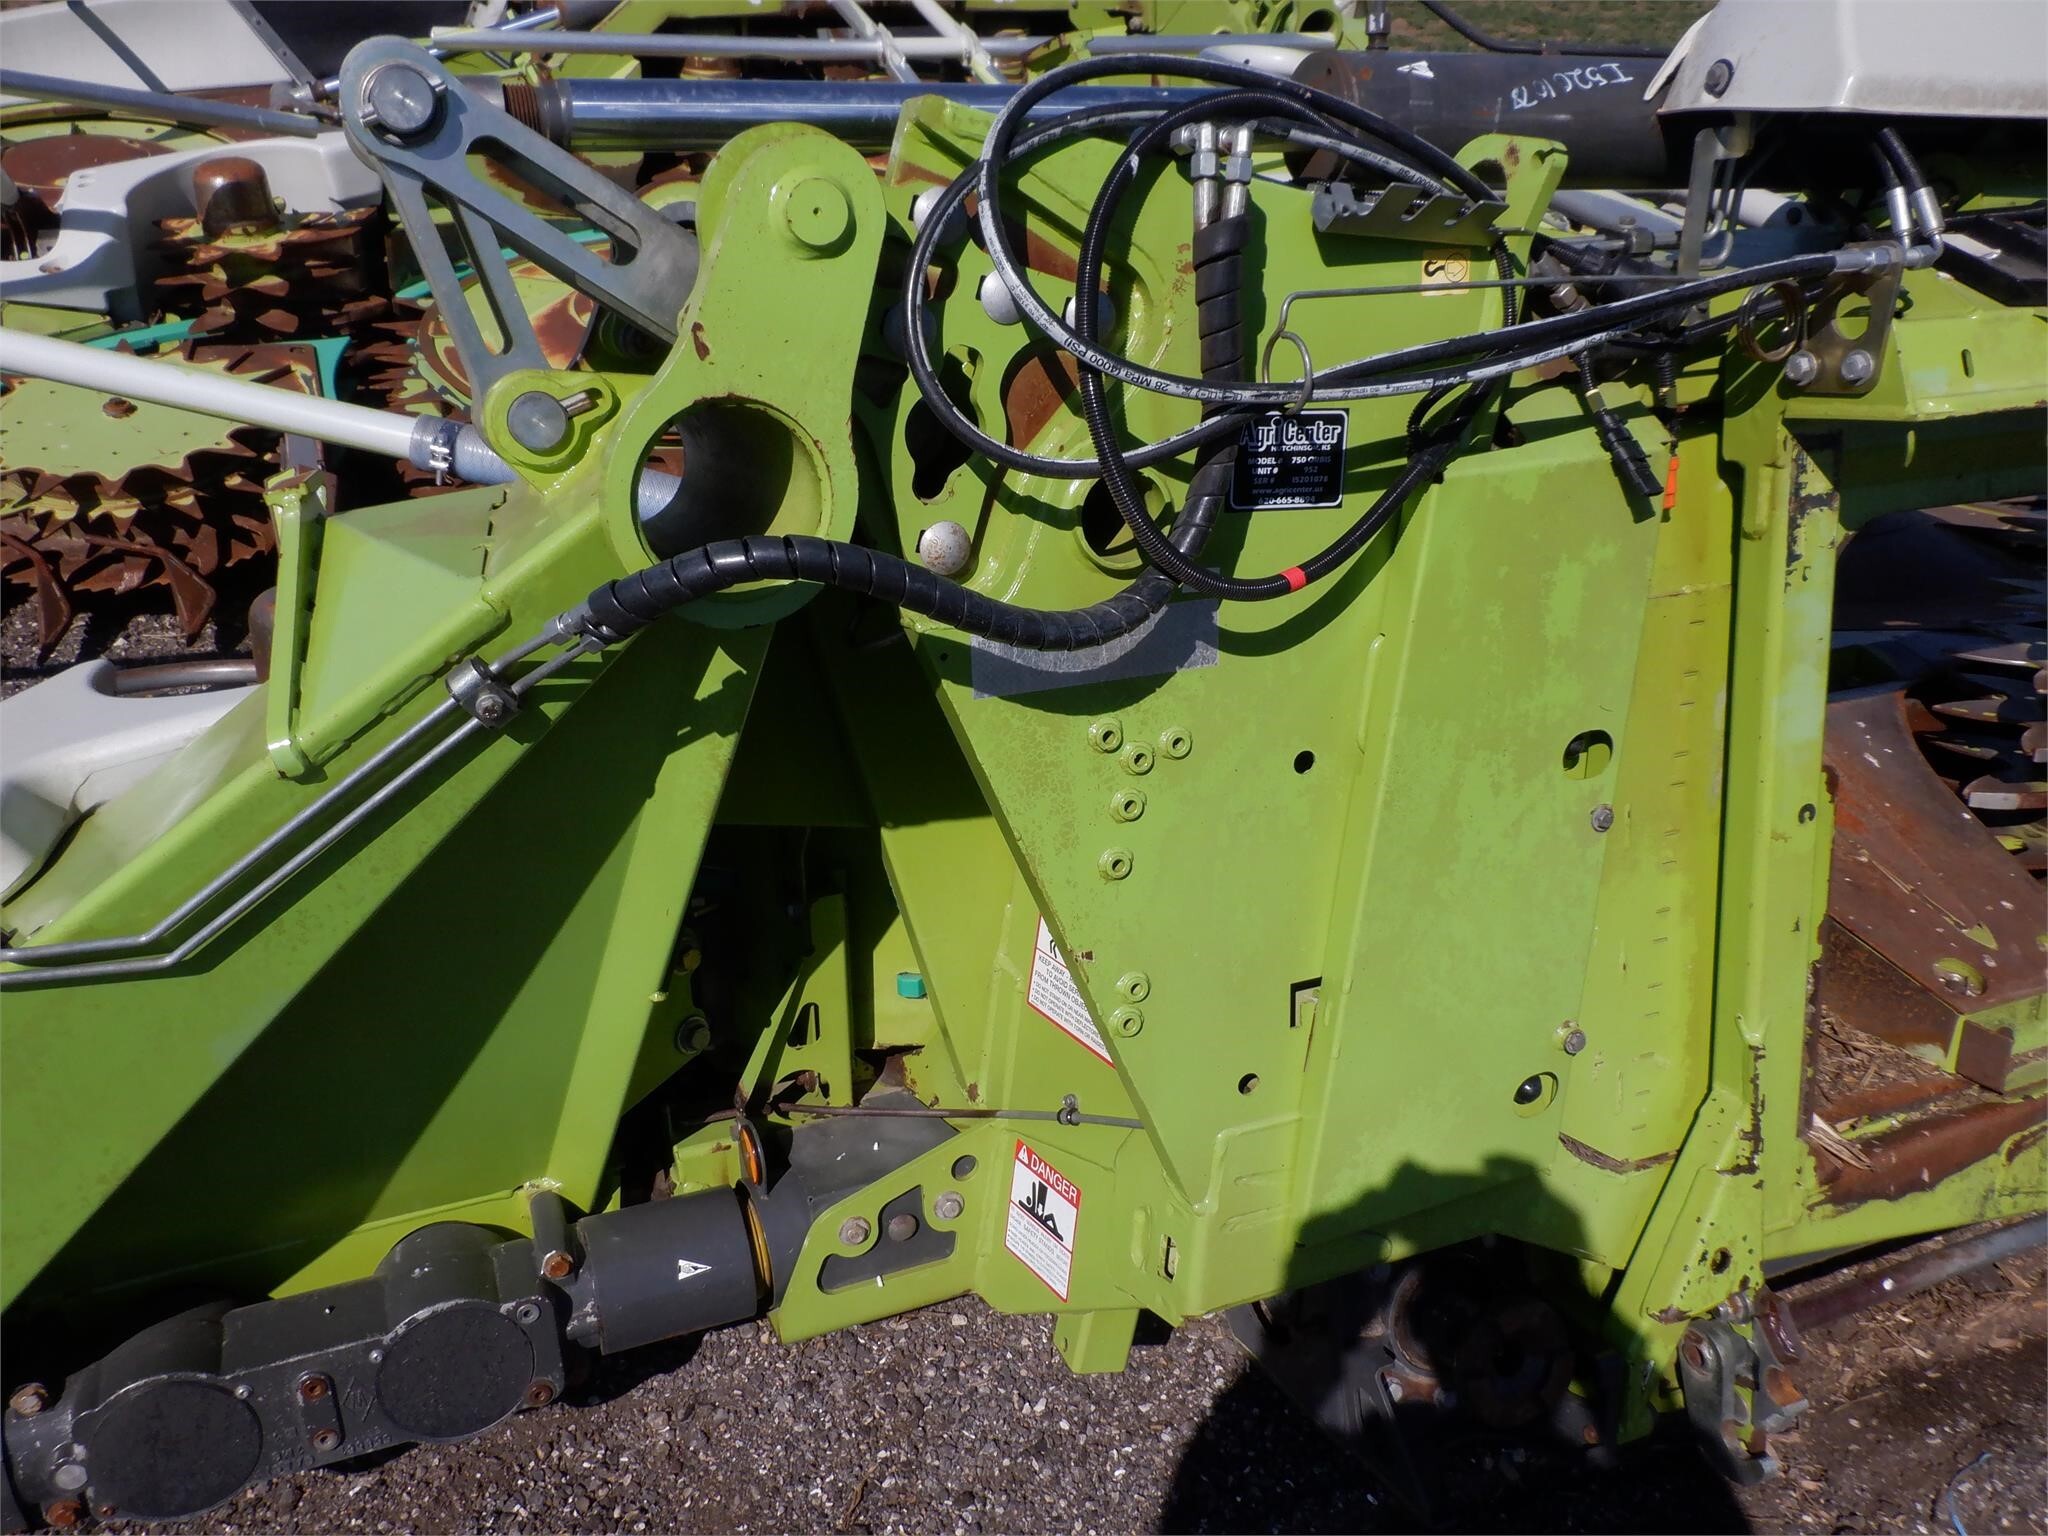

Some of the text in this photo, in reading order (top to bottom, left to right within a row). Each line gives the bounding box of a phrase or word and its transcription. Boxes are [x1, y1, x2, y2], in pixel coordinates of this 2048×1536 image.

[1063, 337, 1088, 358] PSI)
[1089, 353, 1122, 377] (4000
[1155, 380, 1170, 392] 28
[1247, 456, 1277, 465] MODEL
[1291, 455, 1306, 465] 750
[1251, 466, 1272, 475] UNIT
[1038, 955, 1066, 977] KEEP AWAY
[1034, 969, 1049, 985] FROM
[1049, 980, 1071, 1000] THROWN
[1046, 968, 1053, 978] TO
[1053, 973, 1069, 989] AVOID
[1030, 1153, 1078, 1205] DANGER
